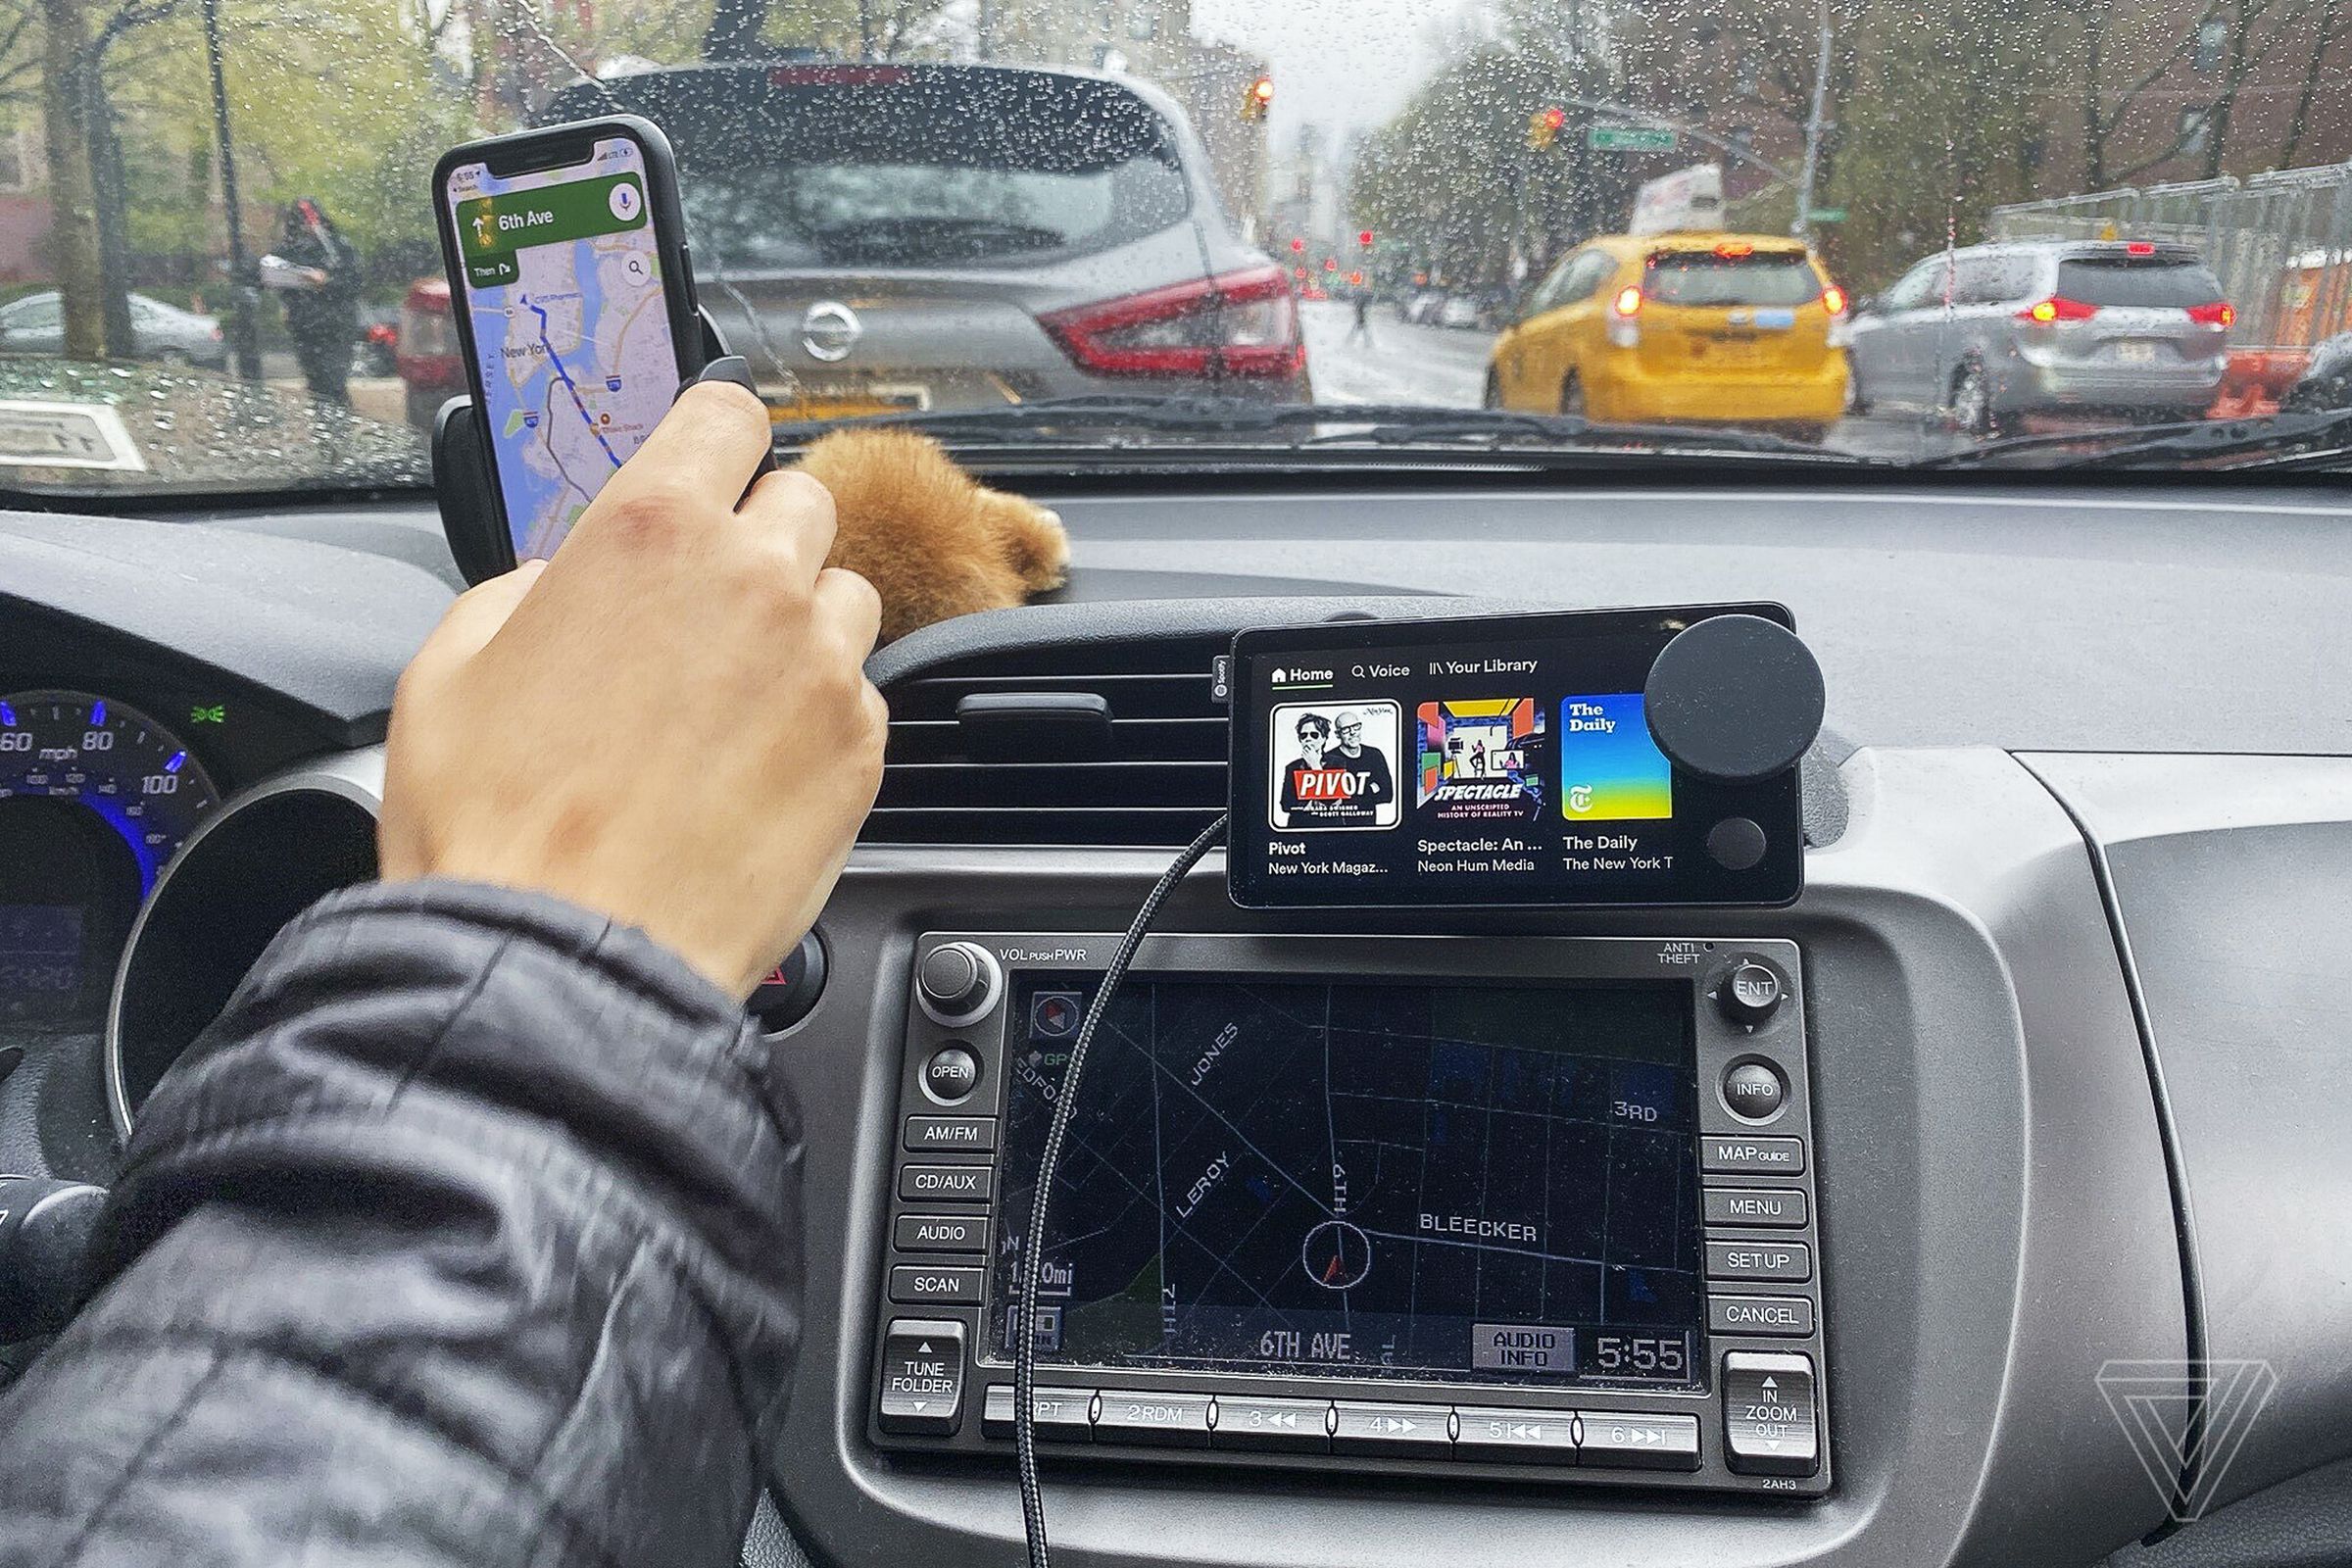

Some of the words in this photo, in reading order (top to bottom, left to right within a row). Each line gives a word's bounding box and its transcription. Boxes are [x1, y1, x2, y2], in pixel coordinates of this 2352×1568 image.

[498, 216, 524, 231] 6th
[527, 210, 554, 226] Ave
[473, 267, 496, 277] Then
[501, 347, 526, 359] New
[1216, 660, 1227, 684] Spotify
[1369, 664, 1410, 678] Voice
[1446, 661, 1481, 674] Your
[1484, 659, 1538, 674] Library
[1290, 668, 1334, 682] Home
[1569, 704, 1603, 716] The
[1569, 718, 1616, 734] Daily
[39, 745, 77, 761] mph
[0, 732, 32, 752] 60
[82, 731, 114, 751] 80
[142, 774, 178, 795] 100
[1299, 772, 1371, 797] PIVOT
[1434, 784, 1524, 802] SPECTACLE
[1268, 842, 1306, 855] Pivot
[1417, 838, 1498, 856] Spectacle:
[1501, 838, 1524, 851] An
[1562, 837, 1593, 850] The
[1597, 835, 1638, 852] Daily
[1268, 862, 1298, 875] New
[1300, 861, 1330, 874] York
[1333, 861, 1389, 876] Magaz...
[1417, 860, 1453, 872] Neon
[1456, 859, 1490, 871] Hum
[1492, 858, 1536, 871] Media
[1562, 858, 1590, 870] The
[1593, 857, 1626, 869] New
[1629, 857, 1661, 869] York
[1000, 949, 1028, 961] VOL
[1029, 952, 1054, 961] PUSH
[1054, 949, 1088, 961] PWR
[1663, 943, 1695, 954] ANTI
[1657, 954, 1700, 964] THEFT
[1736, 981, 1773, 997] ENT
[1191, 1022, 1240, 1087] JONES
[932, 1065, 970, 1079] OPEN
[1736, 1083, 1774, 1098] INFO
[1614, 1101, 1658, 1123] 3RD
[924, 1127, 978, 1142] AM/FM
[1718, 1146, 1756, 1161] MAP
[1757, 1152, 1790, 1162] GUIDE
[914, 1174, 977, 1190] CD/AUX
[1175, 1151, 1231, 1219] LEROY
[1333, 1163, 1348, 1214] 6TH
[1730, 1199, 1783, 1216] MENU
[917, 1226, 966, 1242] AUDIO
[1420, 1213, 1537, 1242] BLEECKER
[913, 1277, 960, 1293] SCAN
[1726, 1305, 1799, 1325] CANCEL
[1260, 1330, 1300, 1359] 6TH
[1311, 1332, 1351, 1360] AVE
[1493, 1331, 1556, 1349] AUDIO
[1500, 1350, 1548, 1367] INFO
[1597, 1337, 1684, 1371] 5:55
[905, 1361, 946, 1377] TUNE
[891, 1377, 954, 1394] FOLDER
[1762, 1390, 1778, 1404] IN
[1248, 1409, 1263, 1427] 3
[1745, 1405, 1798, 1422] ZOOM
[1370, 1415, 1383, 1432] 4
[1489, 1422, 1502, 1440] 5
[1755, 1423, 1788, 1438] OUT
[1610, 1427, 1626, 1445] 6
[1762, 1478, 1797, 1491] 2AH3
